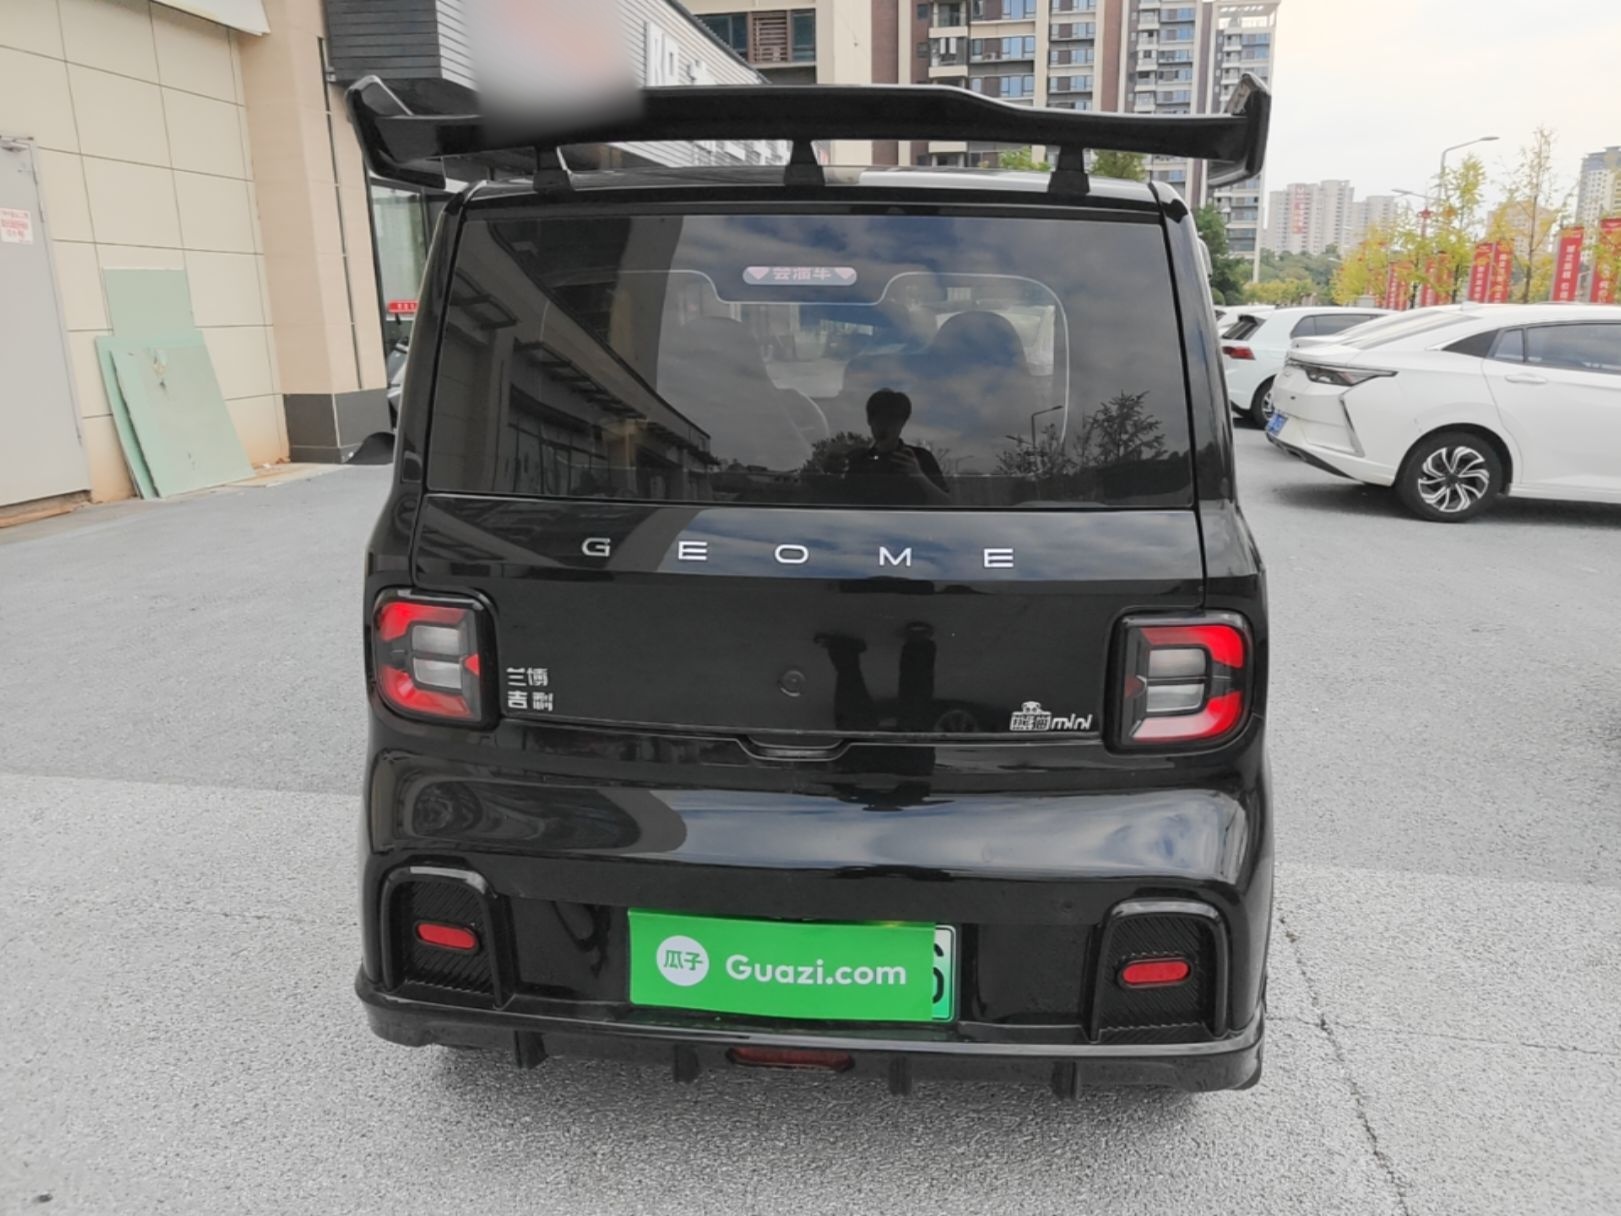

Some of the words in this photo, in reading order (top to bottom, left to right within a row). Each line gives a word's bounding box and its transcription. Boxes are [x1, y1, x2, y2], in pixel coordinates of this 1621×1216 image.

[581, 537, 1014, 568] GEOME
[663, 949, 703, 972] 瓜子
[725, 953, 907, 986] Guazi.com
